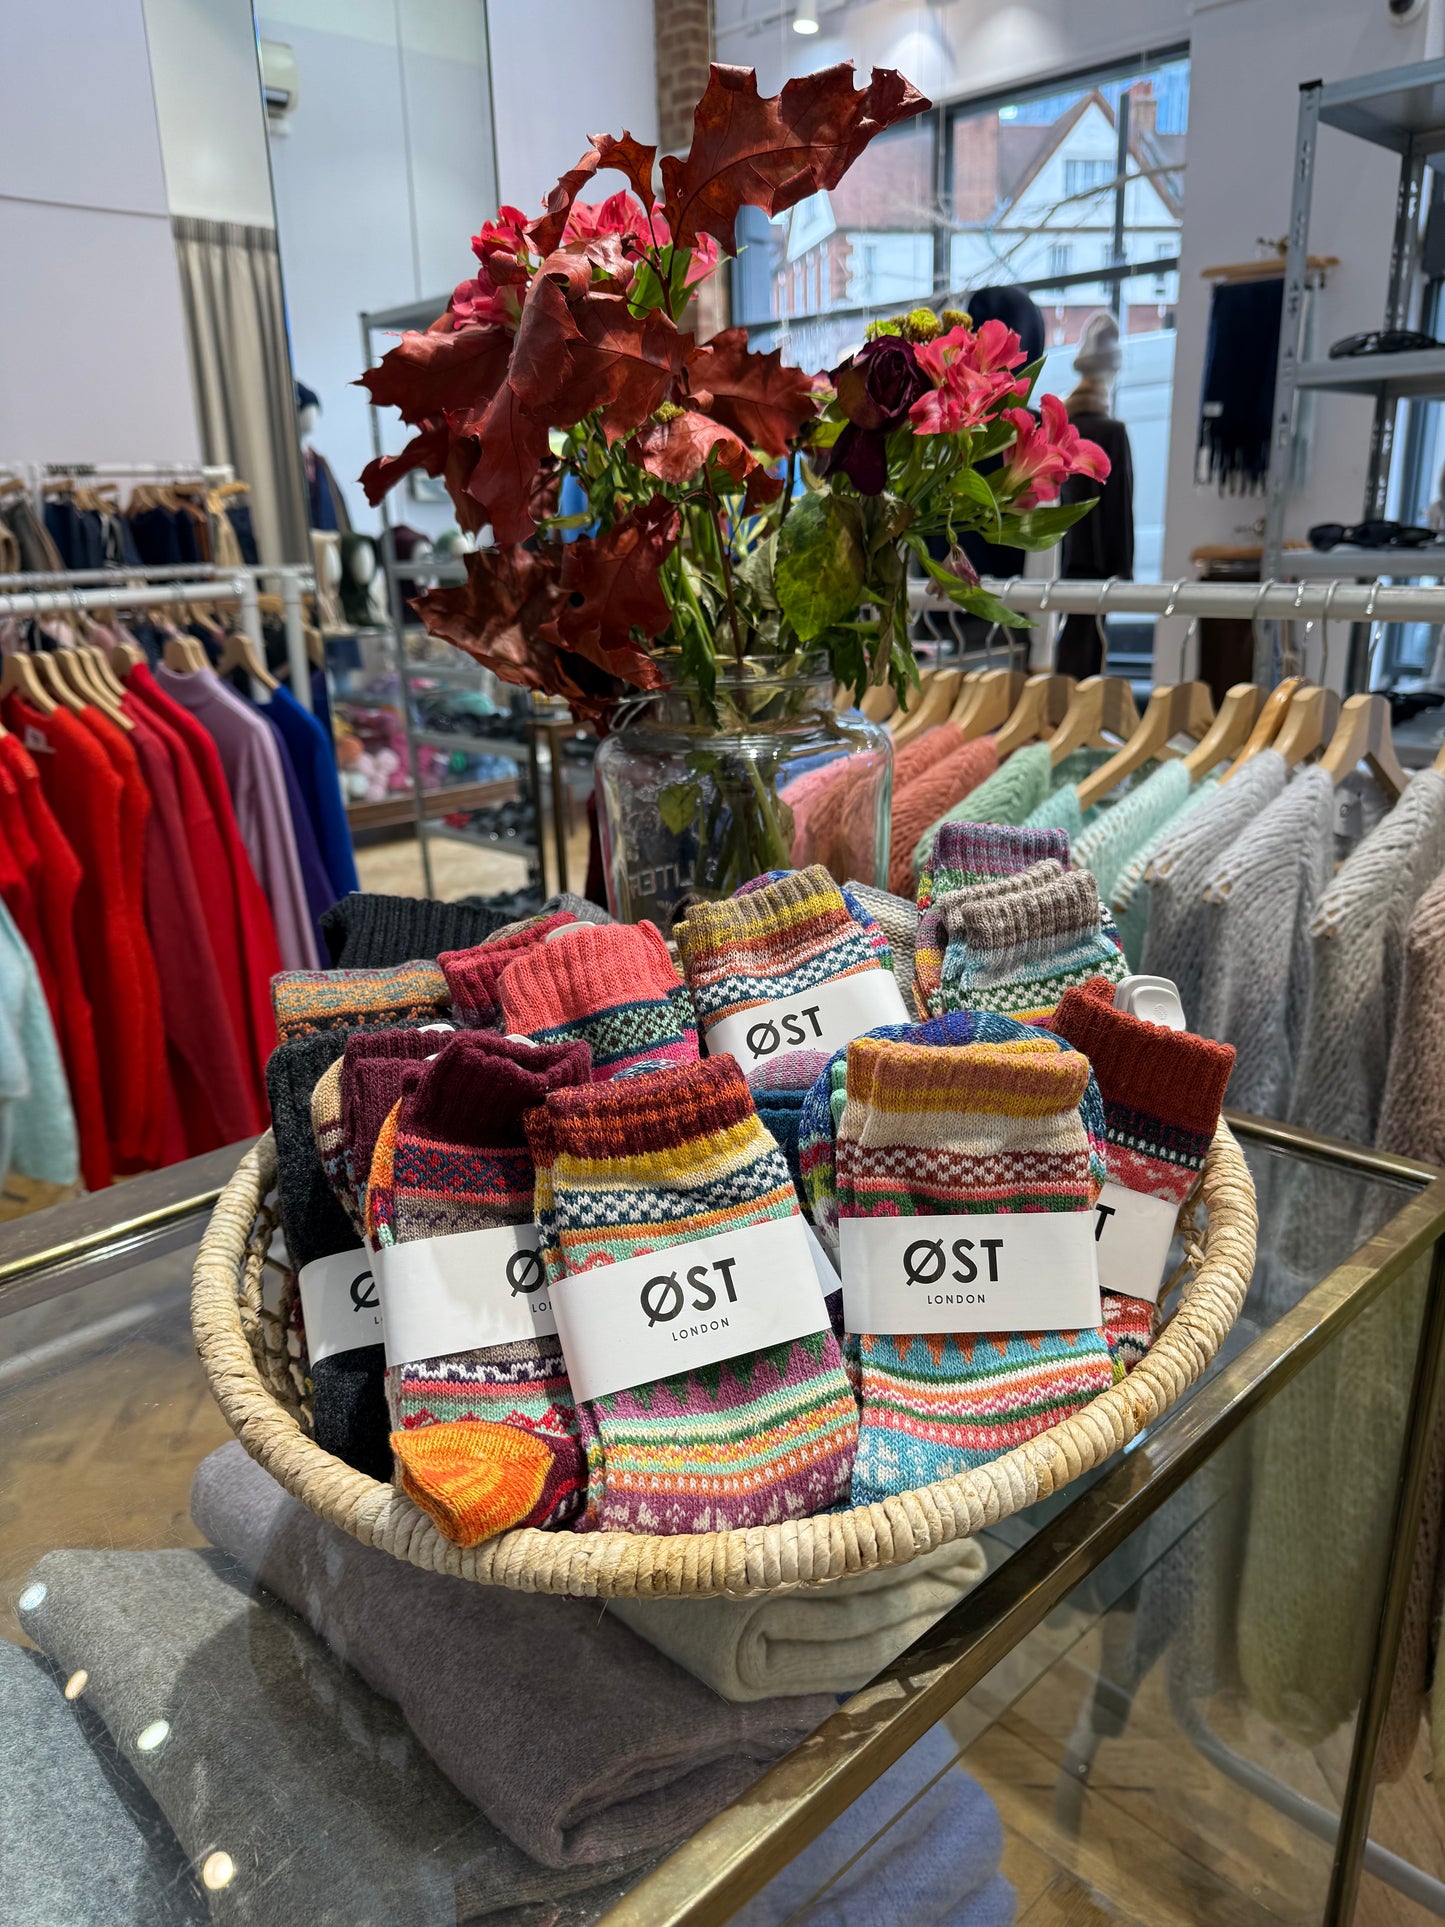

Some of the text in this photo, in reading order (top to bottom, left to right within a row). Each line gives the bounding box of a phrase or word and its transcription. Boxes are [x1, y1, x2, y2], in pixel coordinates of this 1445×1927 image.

[747, 1006, 822, 1060] ØST
[904, 1239, 1003, 1287] ØST
[641, 1258, 737, 1327] ØST
[927, 1294, 985, 1304] LONDON
[672, 1318, 729, 1341] LONDON
